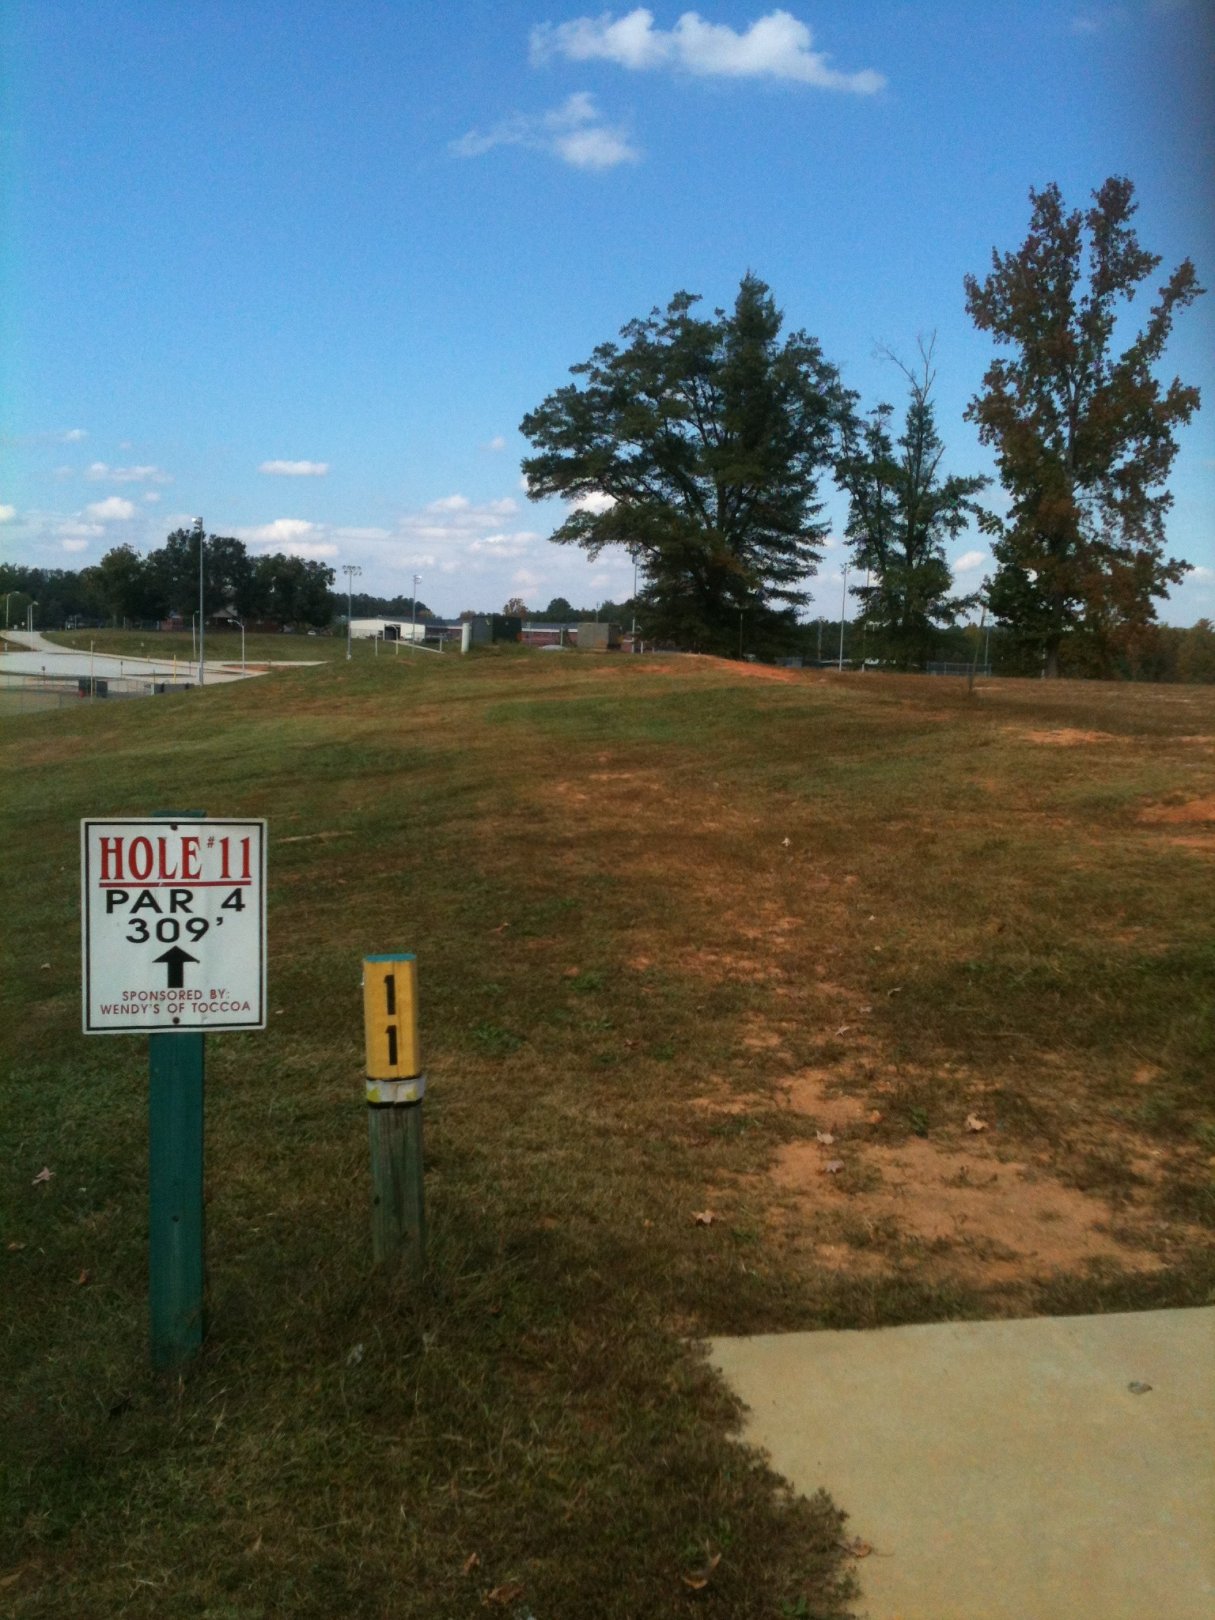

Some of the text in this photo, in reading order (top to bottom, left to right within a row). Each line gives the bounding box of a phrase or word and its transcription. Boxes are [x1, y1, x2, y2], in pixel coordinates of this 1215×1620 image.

[99, 836, 202, 880] HOLE
[106, 888, 246, 914] PAR 4
[122, 989, 230, 1001] SPONSORED BY:
[100, 1001, 251, 1015] WENDY'S OF TOCCOA
